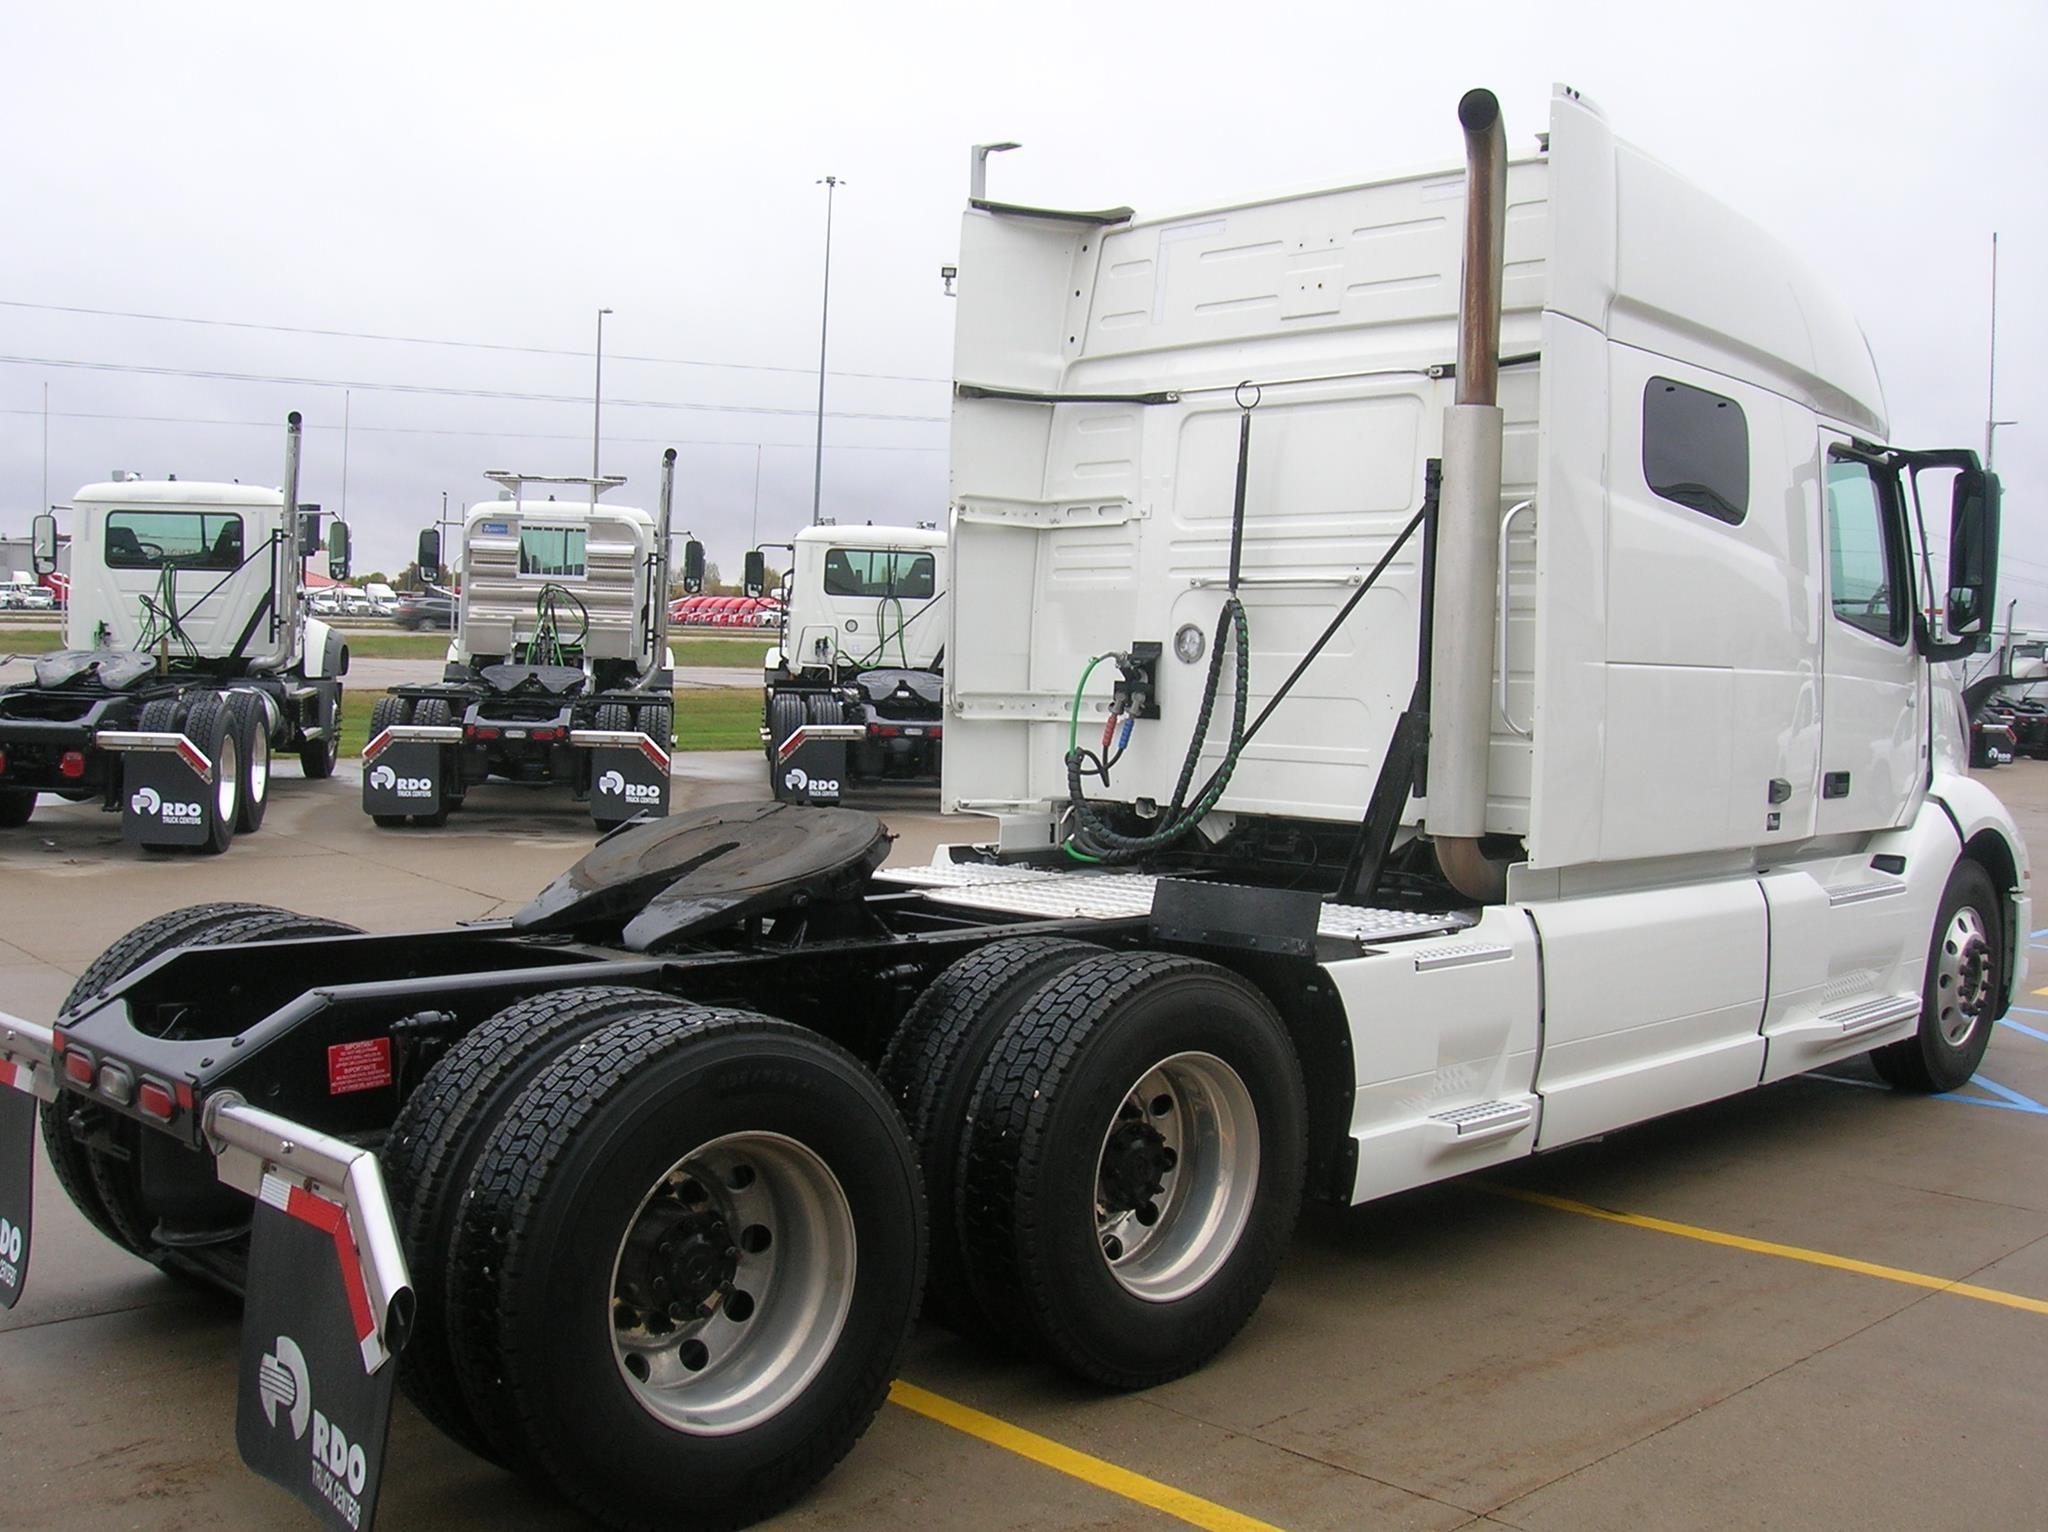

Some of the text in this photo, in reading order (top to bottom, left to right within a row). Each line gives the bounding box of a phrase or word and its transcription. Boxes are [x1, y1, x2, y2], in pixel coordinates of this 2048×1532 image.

[397, 778, 432, 790] RDO
[625, 784, 660, 797] RDO
[809, 780, 839, 790] RDO
[162, 802, 202, 817] RDO
[162, 816, 202, 825] TRUCK CENTERS
[0, 1217, 22, 1263] DO
[312, 1408, 367, 1496] RDO
[312, 1459, 361, 1531] TRUCK CENTERS
